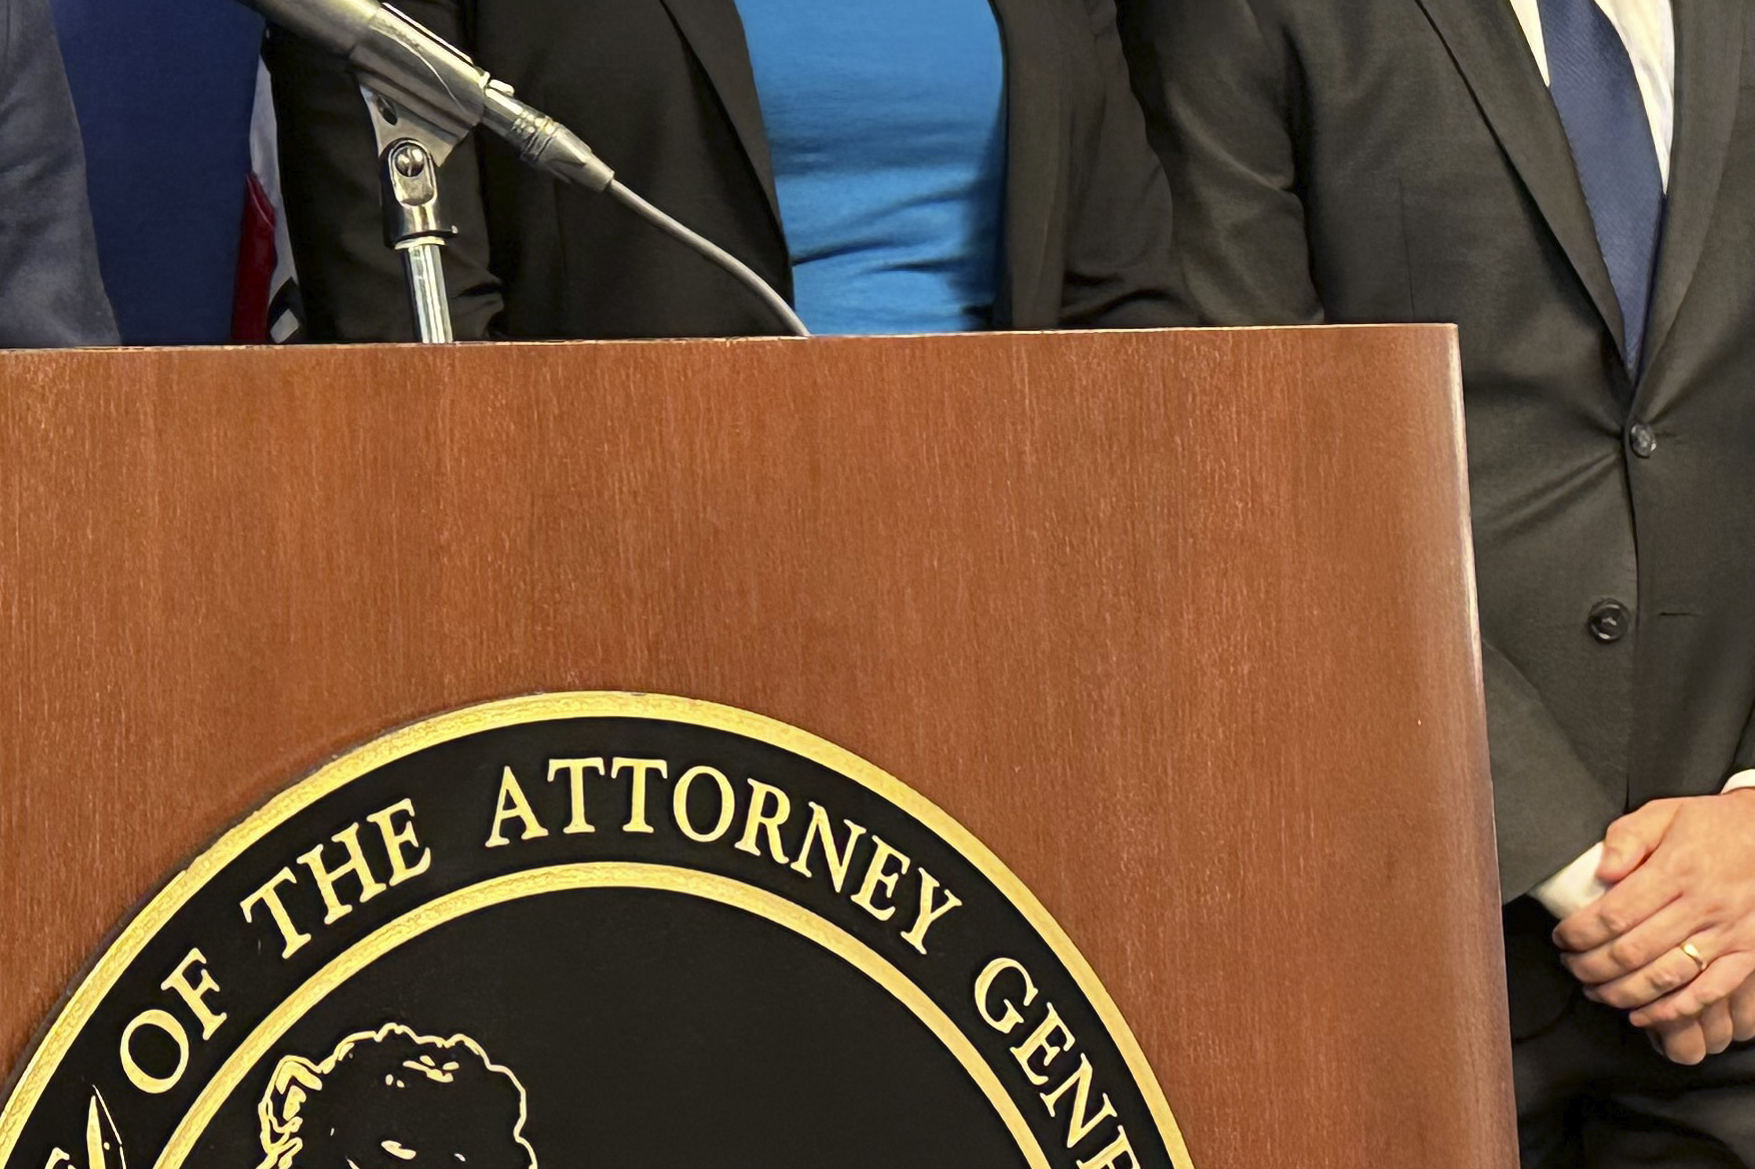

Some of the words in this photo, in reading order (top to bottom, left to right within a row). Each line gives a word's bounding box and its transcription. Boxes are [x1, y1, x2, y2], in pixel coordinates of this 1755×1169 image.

[119, 947, 228, 1094] OF
[239, 797, 432, 960] THE
[484, 756, 963, 955] ATTORNEY
